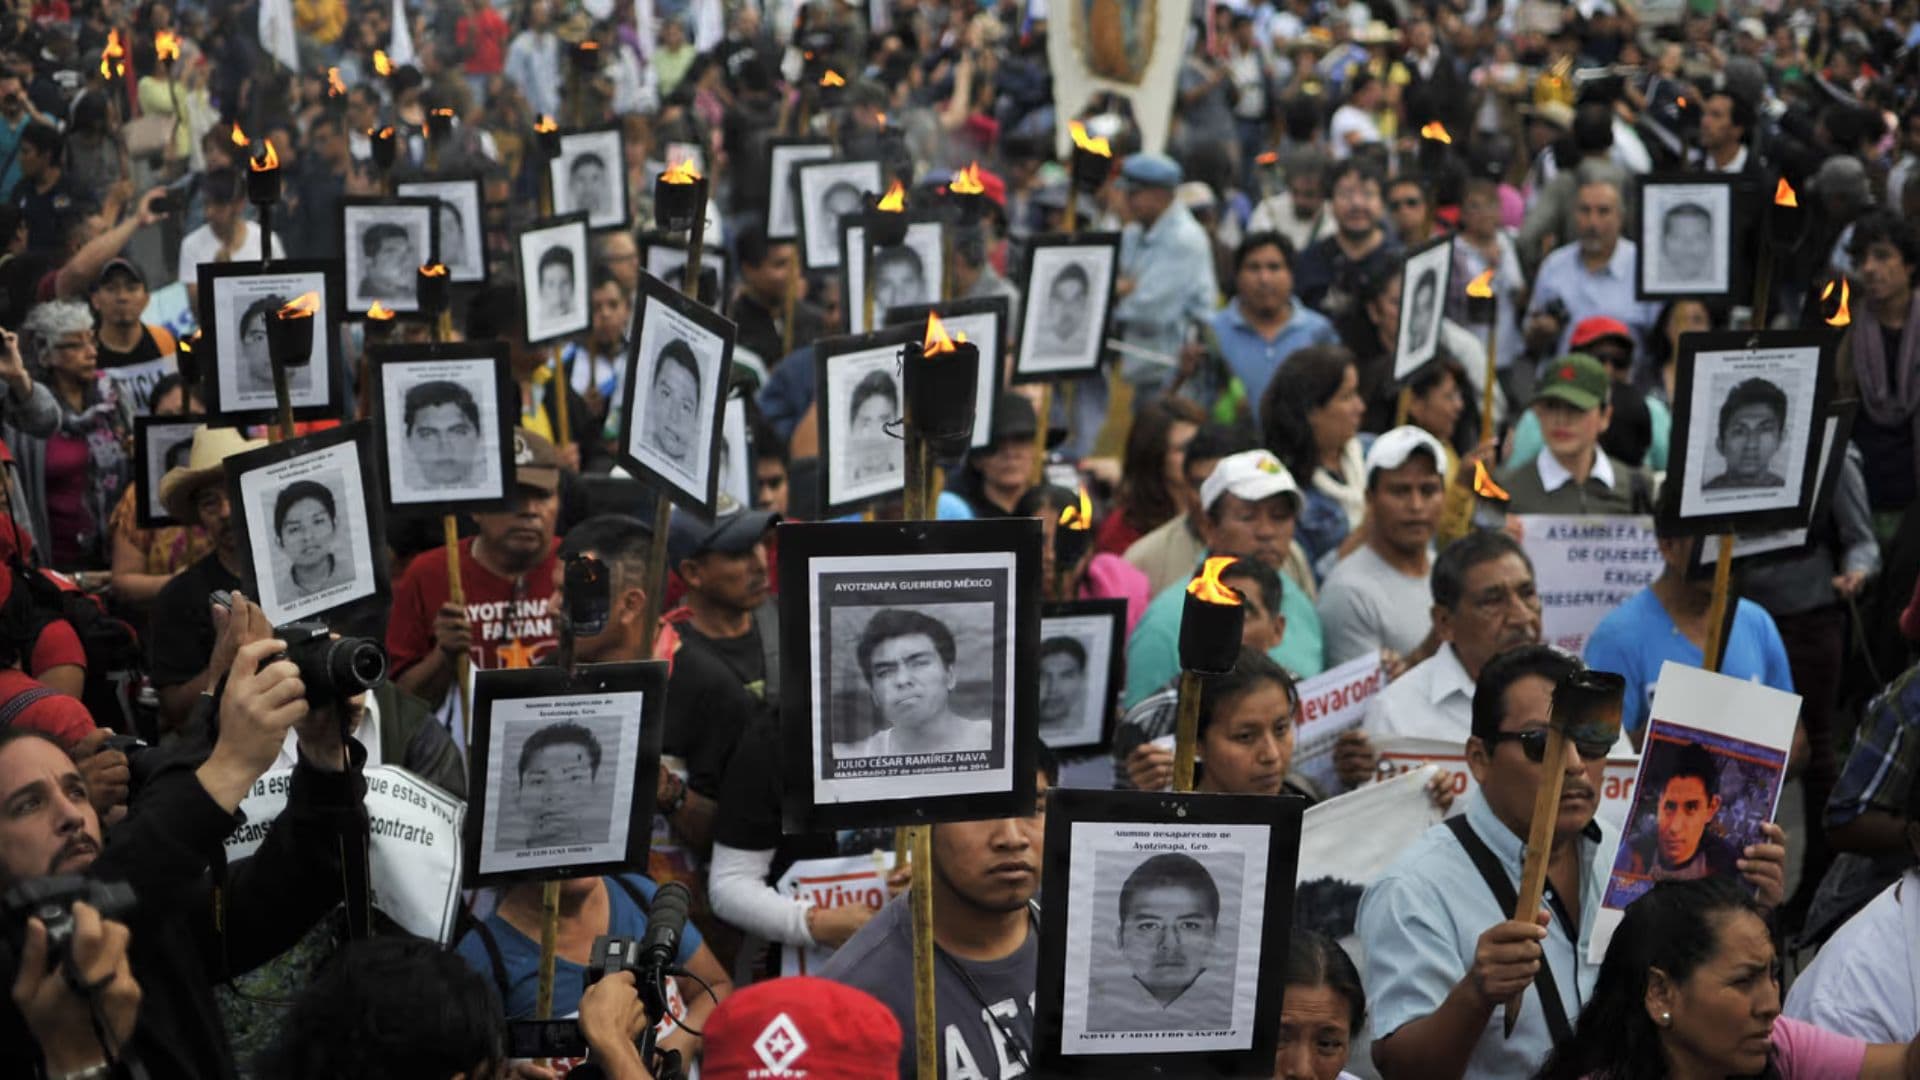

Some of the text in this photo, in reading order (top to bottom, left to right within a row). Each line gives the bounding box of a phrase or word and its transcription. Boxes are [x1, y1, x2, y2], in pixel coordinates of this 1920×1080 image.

[1547, 525, 1637, 540] ASAMBLEA
[1567, 548, 1589, 562] DE
[834, 577, 993, 592] AYOTZINAPA GUERRERO MÉXICO
[482, 618, 552, 641] FALTAN
[836, 751, 988, 770] JULIO CÉSAR RAMÍREZ NAVA
[900, 767, 910, 775] de
[912, 764, 956, 775] septiembre
[391, 782, 428, 809] estas
[370, 814, 435, 847] contrarte
[1114, 830, 1232, 840] Alumno desaparecido de
[1132, 842, 1210, 852] Ayotzinapa, Gro.
[945, 990, 1036, 1080] AE
[1079, 1032, 1115, 1040] ISRAEL
[1121, 1031, 1185, 1039] CABALLERO
